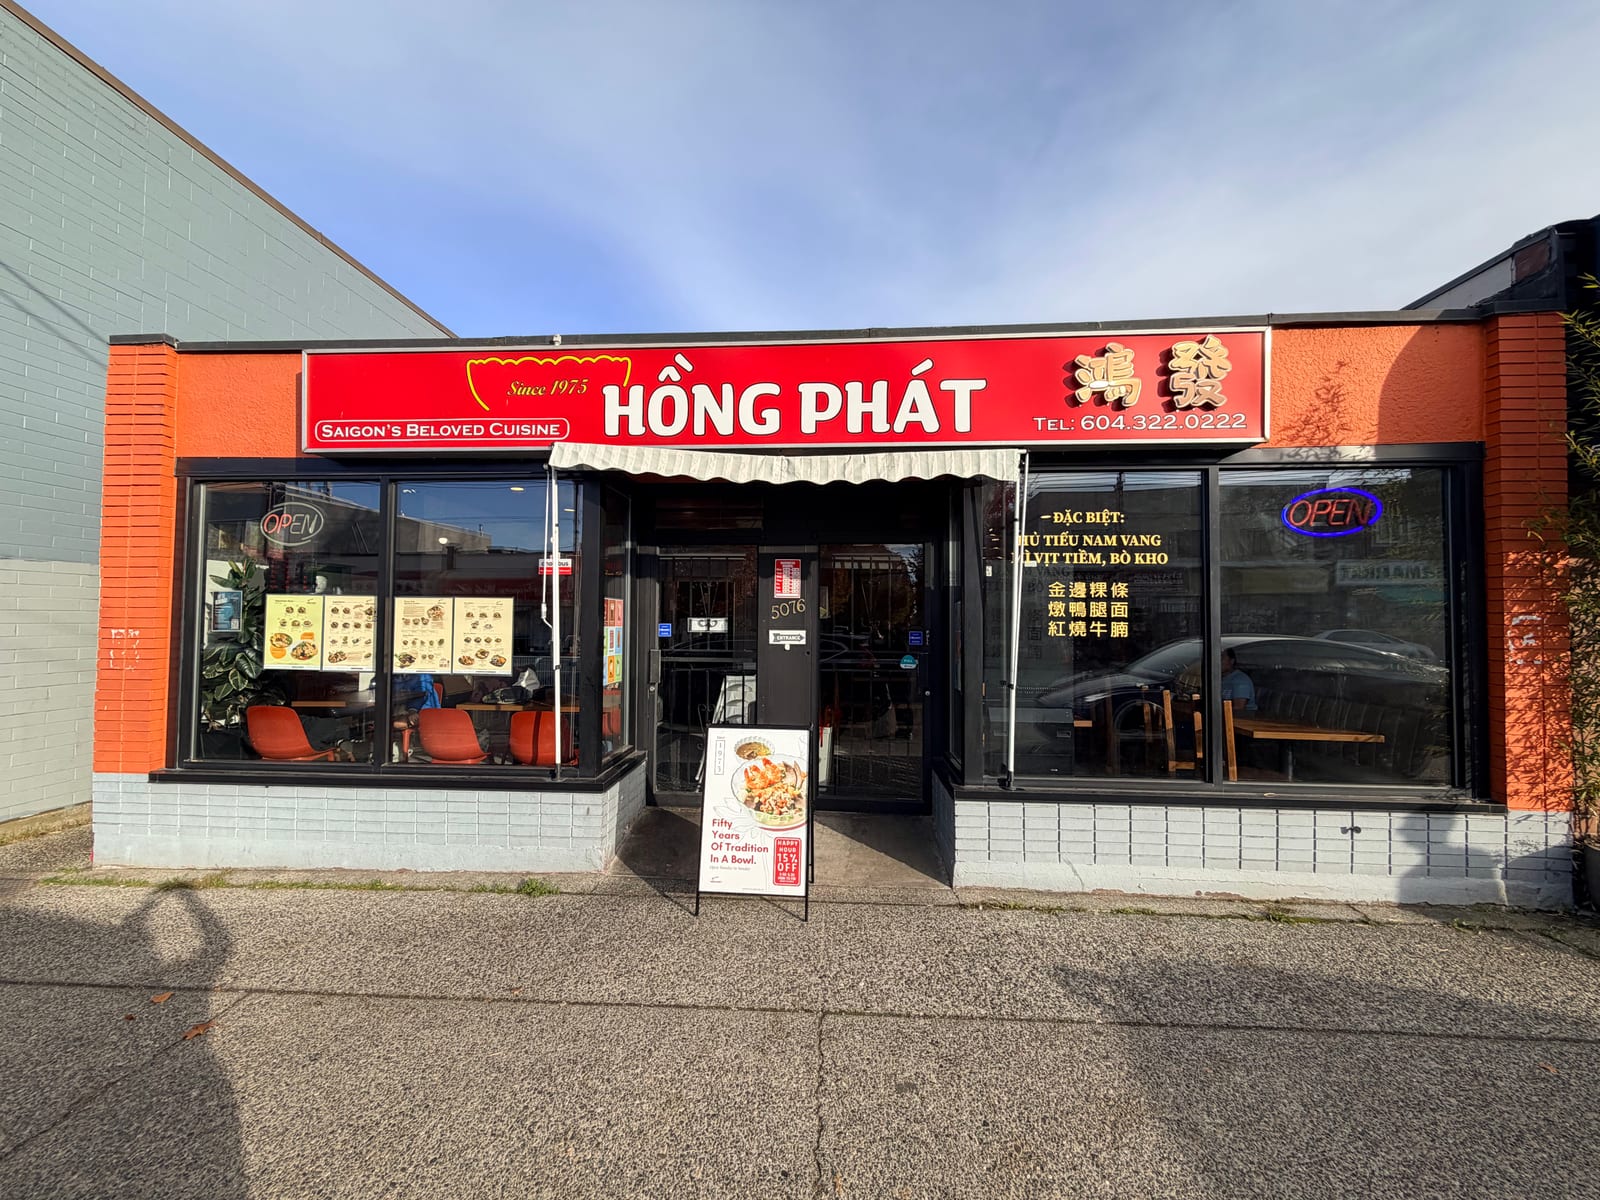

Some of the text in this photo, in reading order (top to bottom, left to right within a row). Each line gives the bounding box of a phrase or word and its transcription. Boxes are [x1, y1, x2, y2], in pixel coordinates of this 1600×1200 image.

[506, 378, 589, 396] Since 1975
[602, 353, 987, 436] HỒNG PHÁT
[406, 423, 485, 437] BELOVED
[489, 422, 561, 436] CUISINE
[1080, 413, 1247, 431] 604.322.0222
[1288, 499, 1374, 526] OPEN
[263, 513, 319, 534] OPEN
[1082, 534, 1118, 546] NAM
[1120, 534, 1162, 547] VANG
[1110, 550, 1131, 565] BÒ
[1134, 552, 1169, 565] KHO
[1048, 581, 1129, 598] 金邊粿條
[771, 598, 806, 620] 5076
[1048, 601, 1129, 618] 燉鴨腿面
[1048, 621, 1129, 638] 紅燒牛腩
[712, 818, 733, 830] Fifty
[712, 830, 740, 840] Years
[711, 842, 769, 853] Of Tradition
[710, 854, 757, 865] In A Bowl.
[777, 853, 798, 863] 15%
[777, 862, 798, 872] OFF
